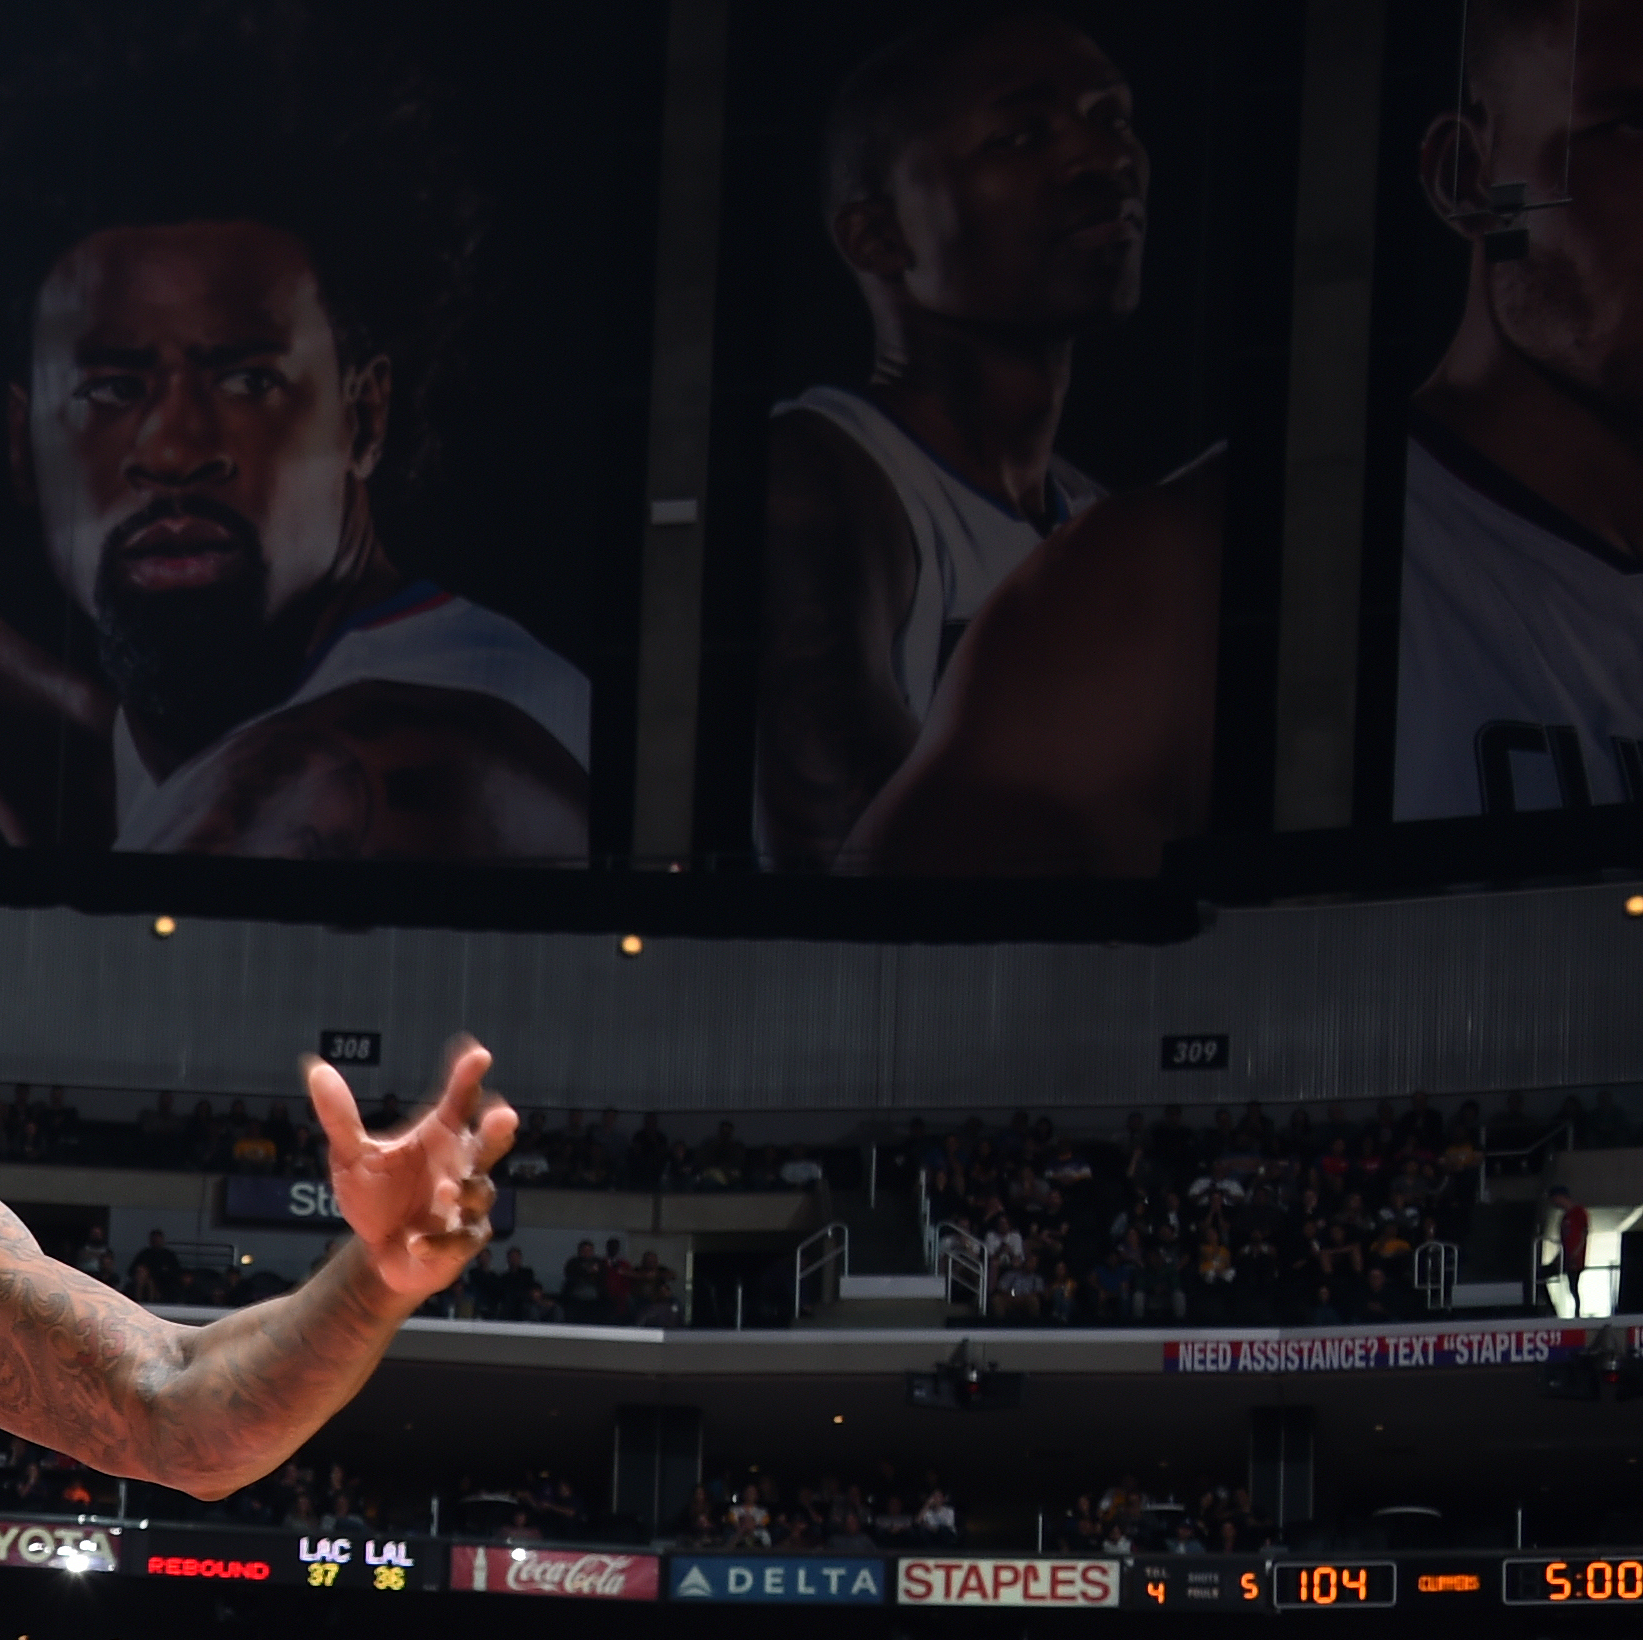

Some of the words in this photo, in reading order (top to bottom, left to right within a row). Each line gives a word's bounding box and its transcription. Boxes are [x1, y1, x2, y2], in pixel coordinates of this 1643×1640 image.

[330, 1037, 371, 1060] 308
[1174, 1041, 1217, 1062] 309
[1178, 1341, 1232, 1373] NEED
[1238, 1338, 1378, 1371] ASSISTANCE?
[1385, 1335, 1439, 1367] TEXT
[299, 1536, 352, 1564] LAC
[366, 1540, 414, 1567] LAL
[148, 1557, 270, 1580] REBOUND
[307, 1563, 341, 1588] 37
[728, 1566, 878, 1596] DELTA
[903, 1562, 1112, 1603] STAPLES
[1545, 1561, 1643, 1600] 5:00
[1147, 1581, 1165, 1604] 4
[1240, 1572, 1259, 1599] 5
[1300, 1565, 1367, 1604] 104
